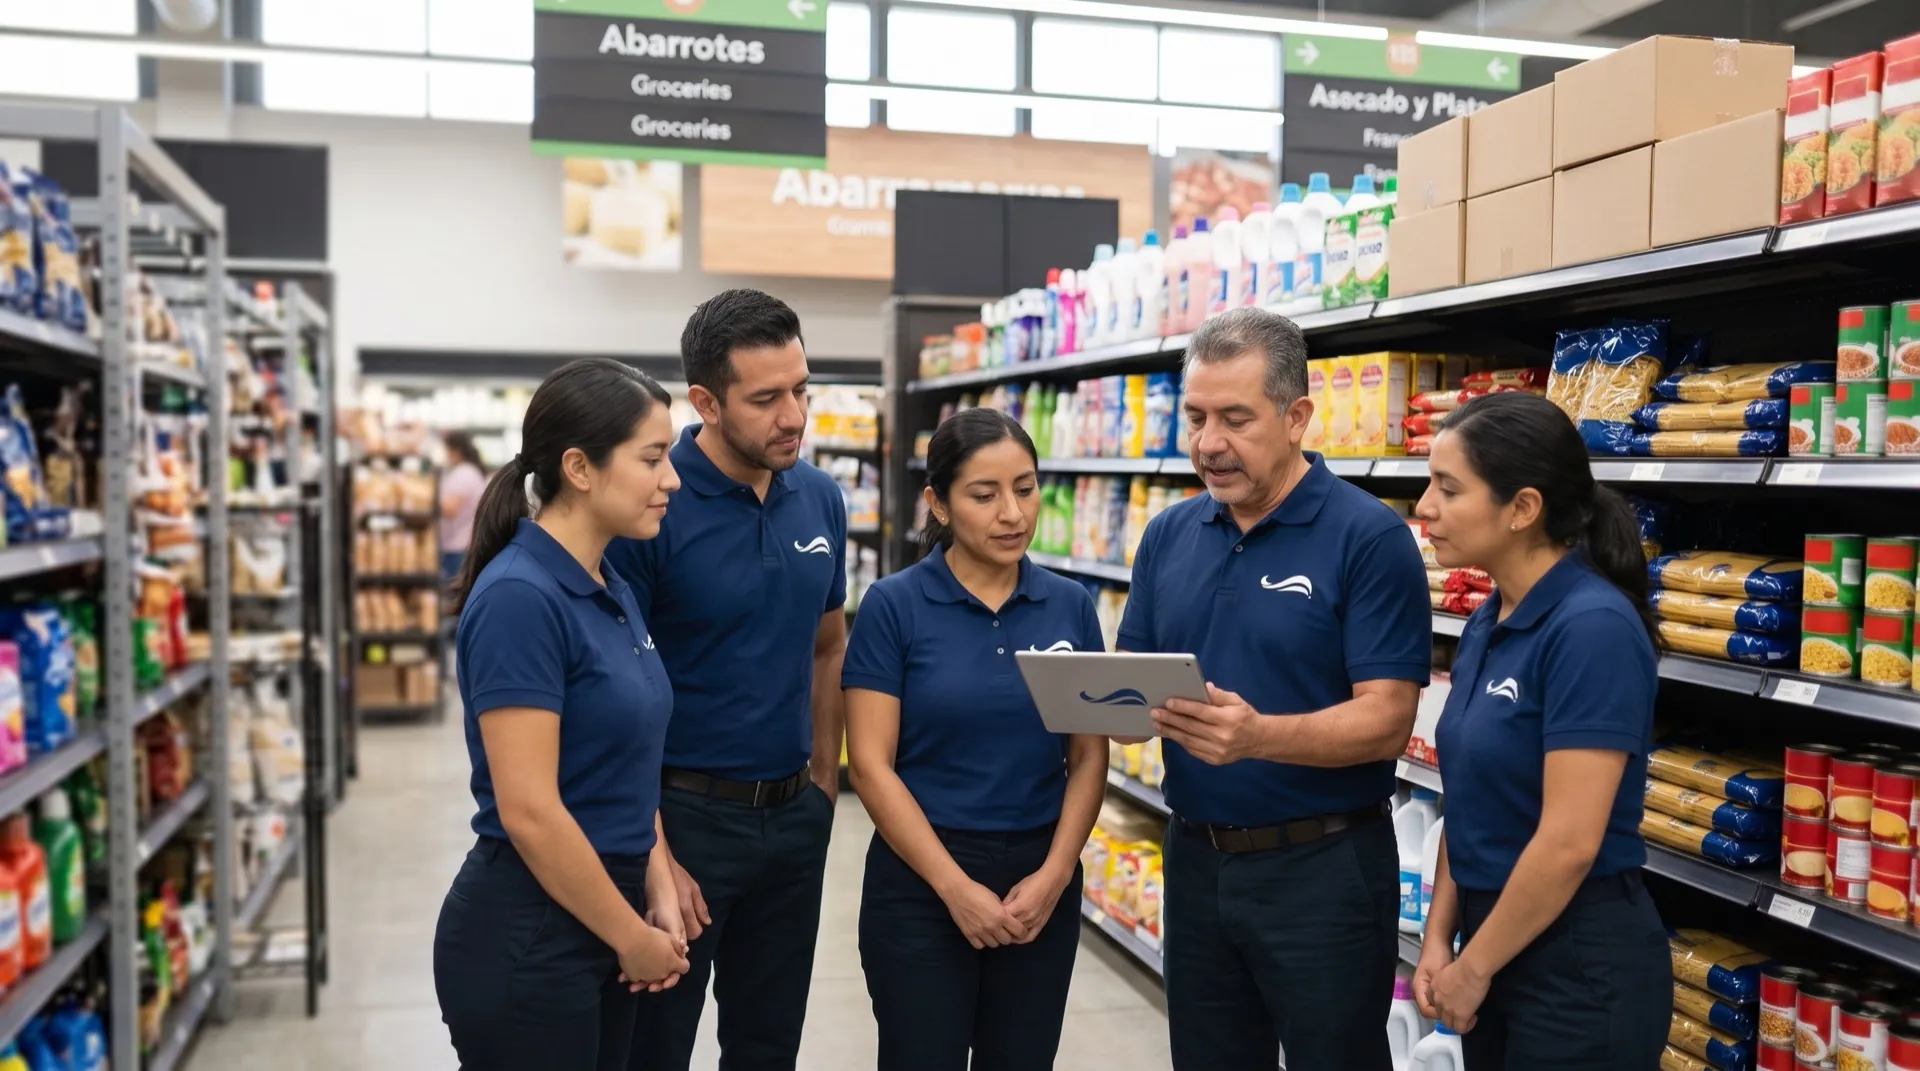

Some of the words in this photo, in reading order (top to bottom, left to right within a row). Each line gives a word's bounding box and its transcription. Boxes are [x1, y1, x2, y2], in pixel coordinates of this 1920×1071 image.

[599, 23, 766, 64] Abarrotes
[631, 73, 733, 101] Groceries
[1412, 96, 1429, 122] y
[631, 114, 732, 141] Groceries
